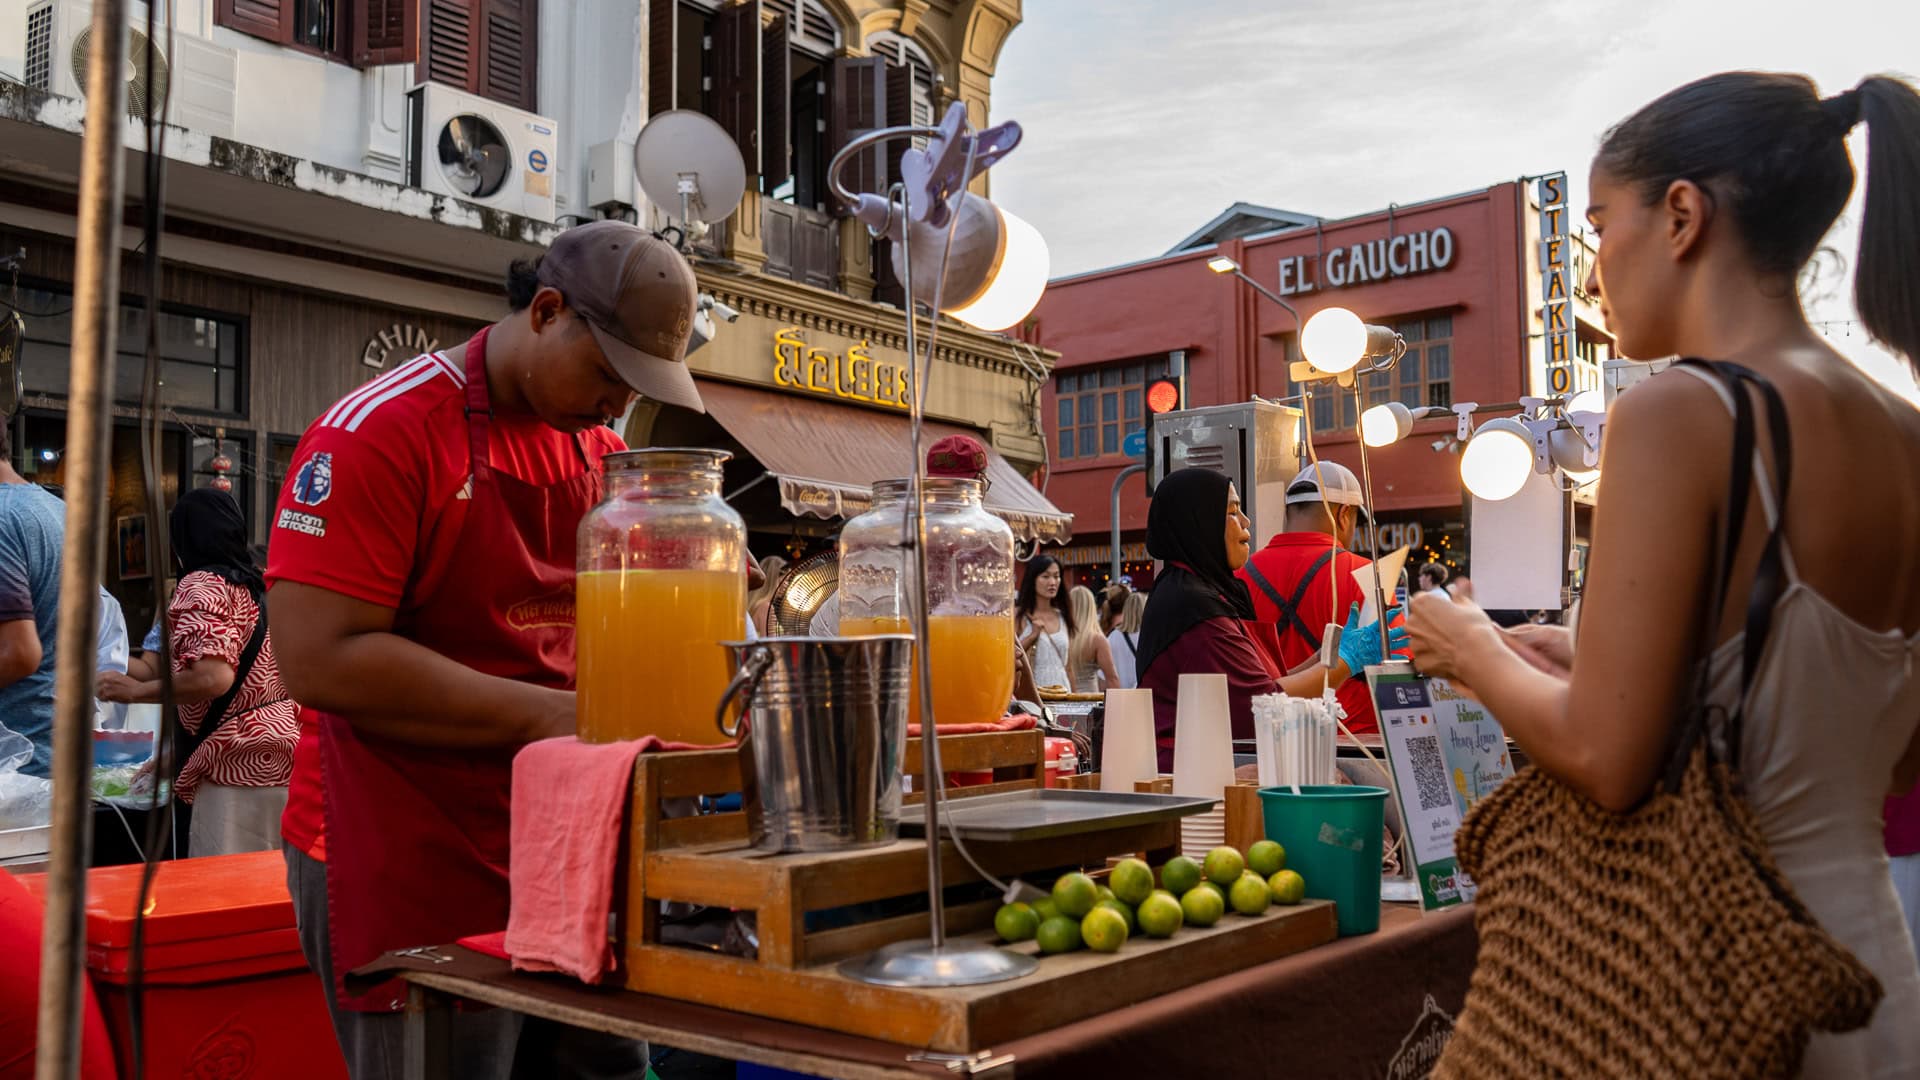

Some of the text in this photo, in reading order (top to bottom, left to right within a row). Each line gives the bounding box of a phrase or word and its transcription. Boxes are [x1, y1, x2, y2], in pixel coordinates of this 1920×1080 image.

[1279, 226, 1454, 297] EL GAUCHO
[1545, 178, 1571, 416] STEAKHO
[363, 323, 440, 369] CHIN
[1350, 521, 1422, 552] AUCHO
